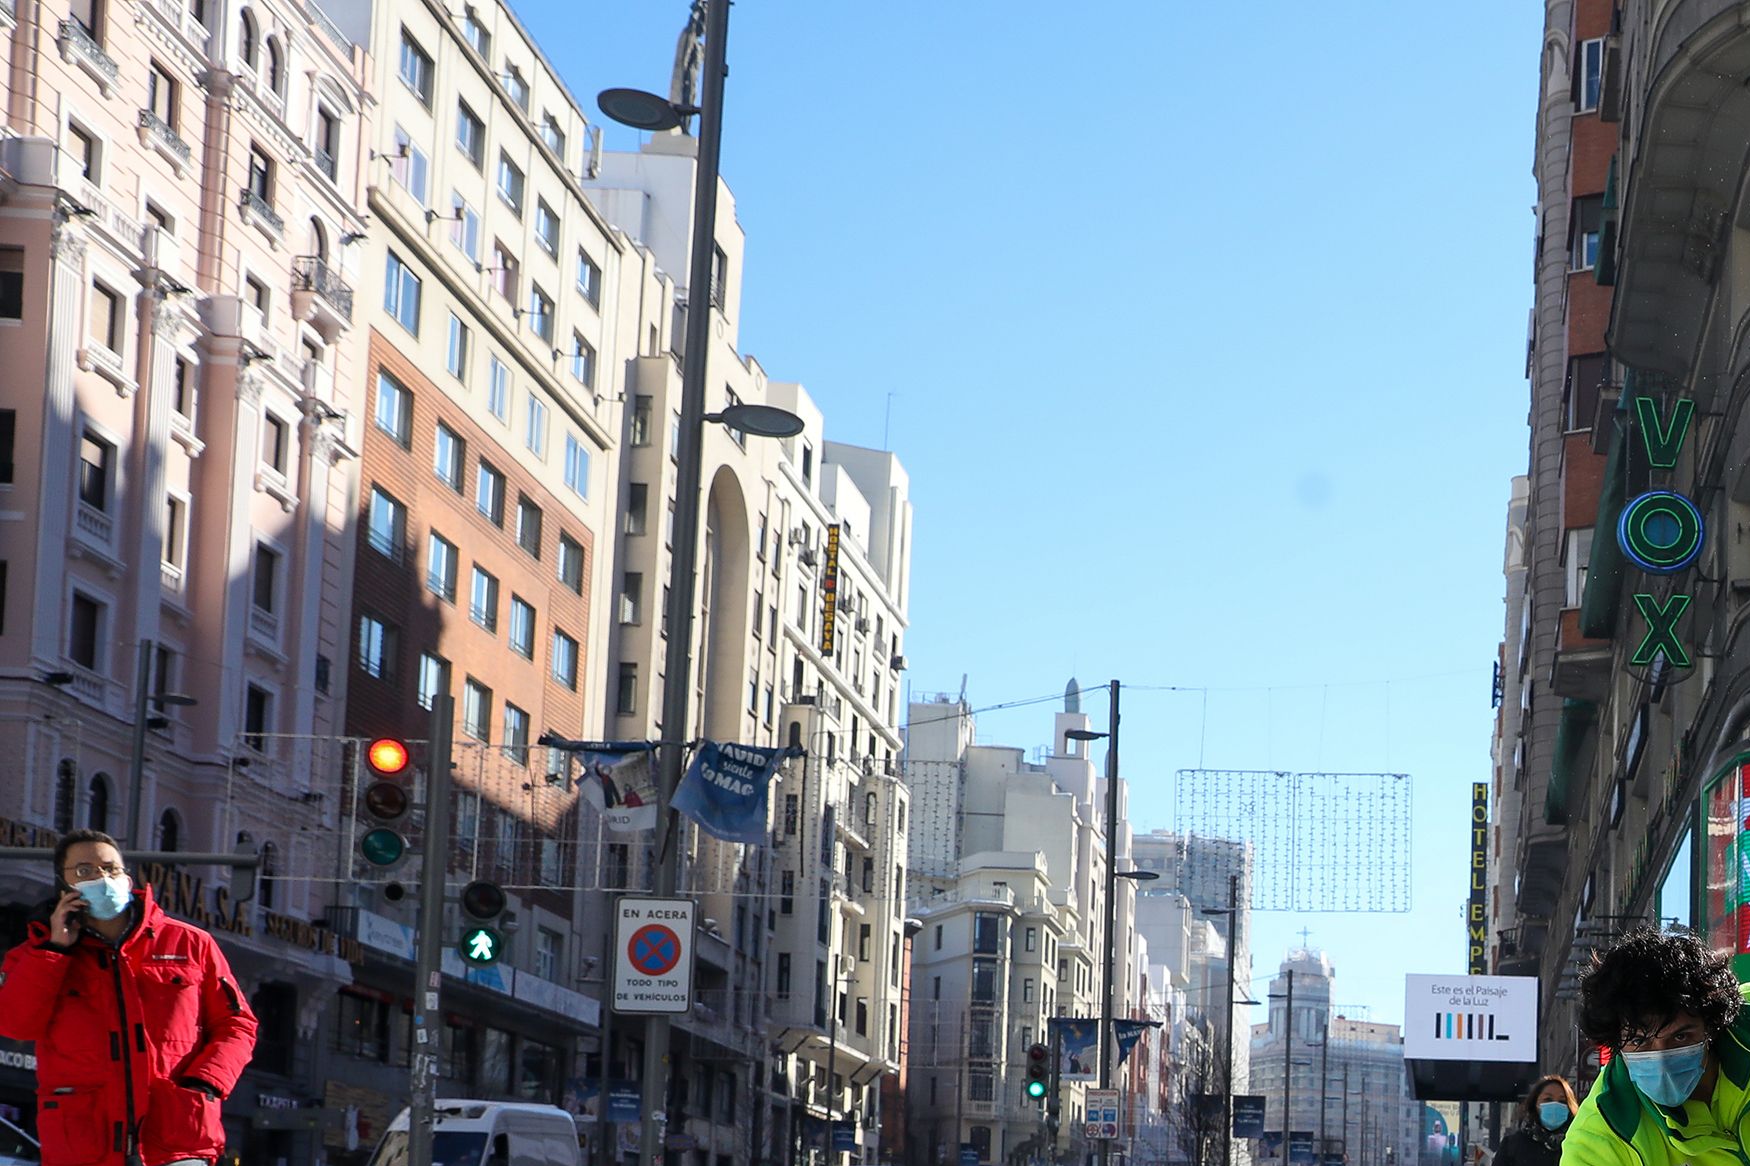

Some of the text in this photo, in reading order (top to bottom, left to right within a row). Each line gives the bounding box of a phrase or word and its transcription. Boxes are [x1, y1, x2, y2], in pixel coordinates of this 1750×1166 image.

[1627, 397, 1699, 666] VOX
[1472, 784, 1488, 890] HOTEL
[623, 909, 688, 919] EN ACERA
[634, 993, 686, 1001] VEHÍCULOS
[1432, 984, 1451, 995] Este
[1465, 985, 1474, 995] el
[1476, 985, 1508, 998] Paisaje
[1449, 996, 1488, 1006] de la Luz
